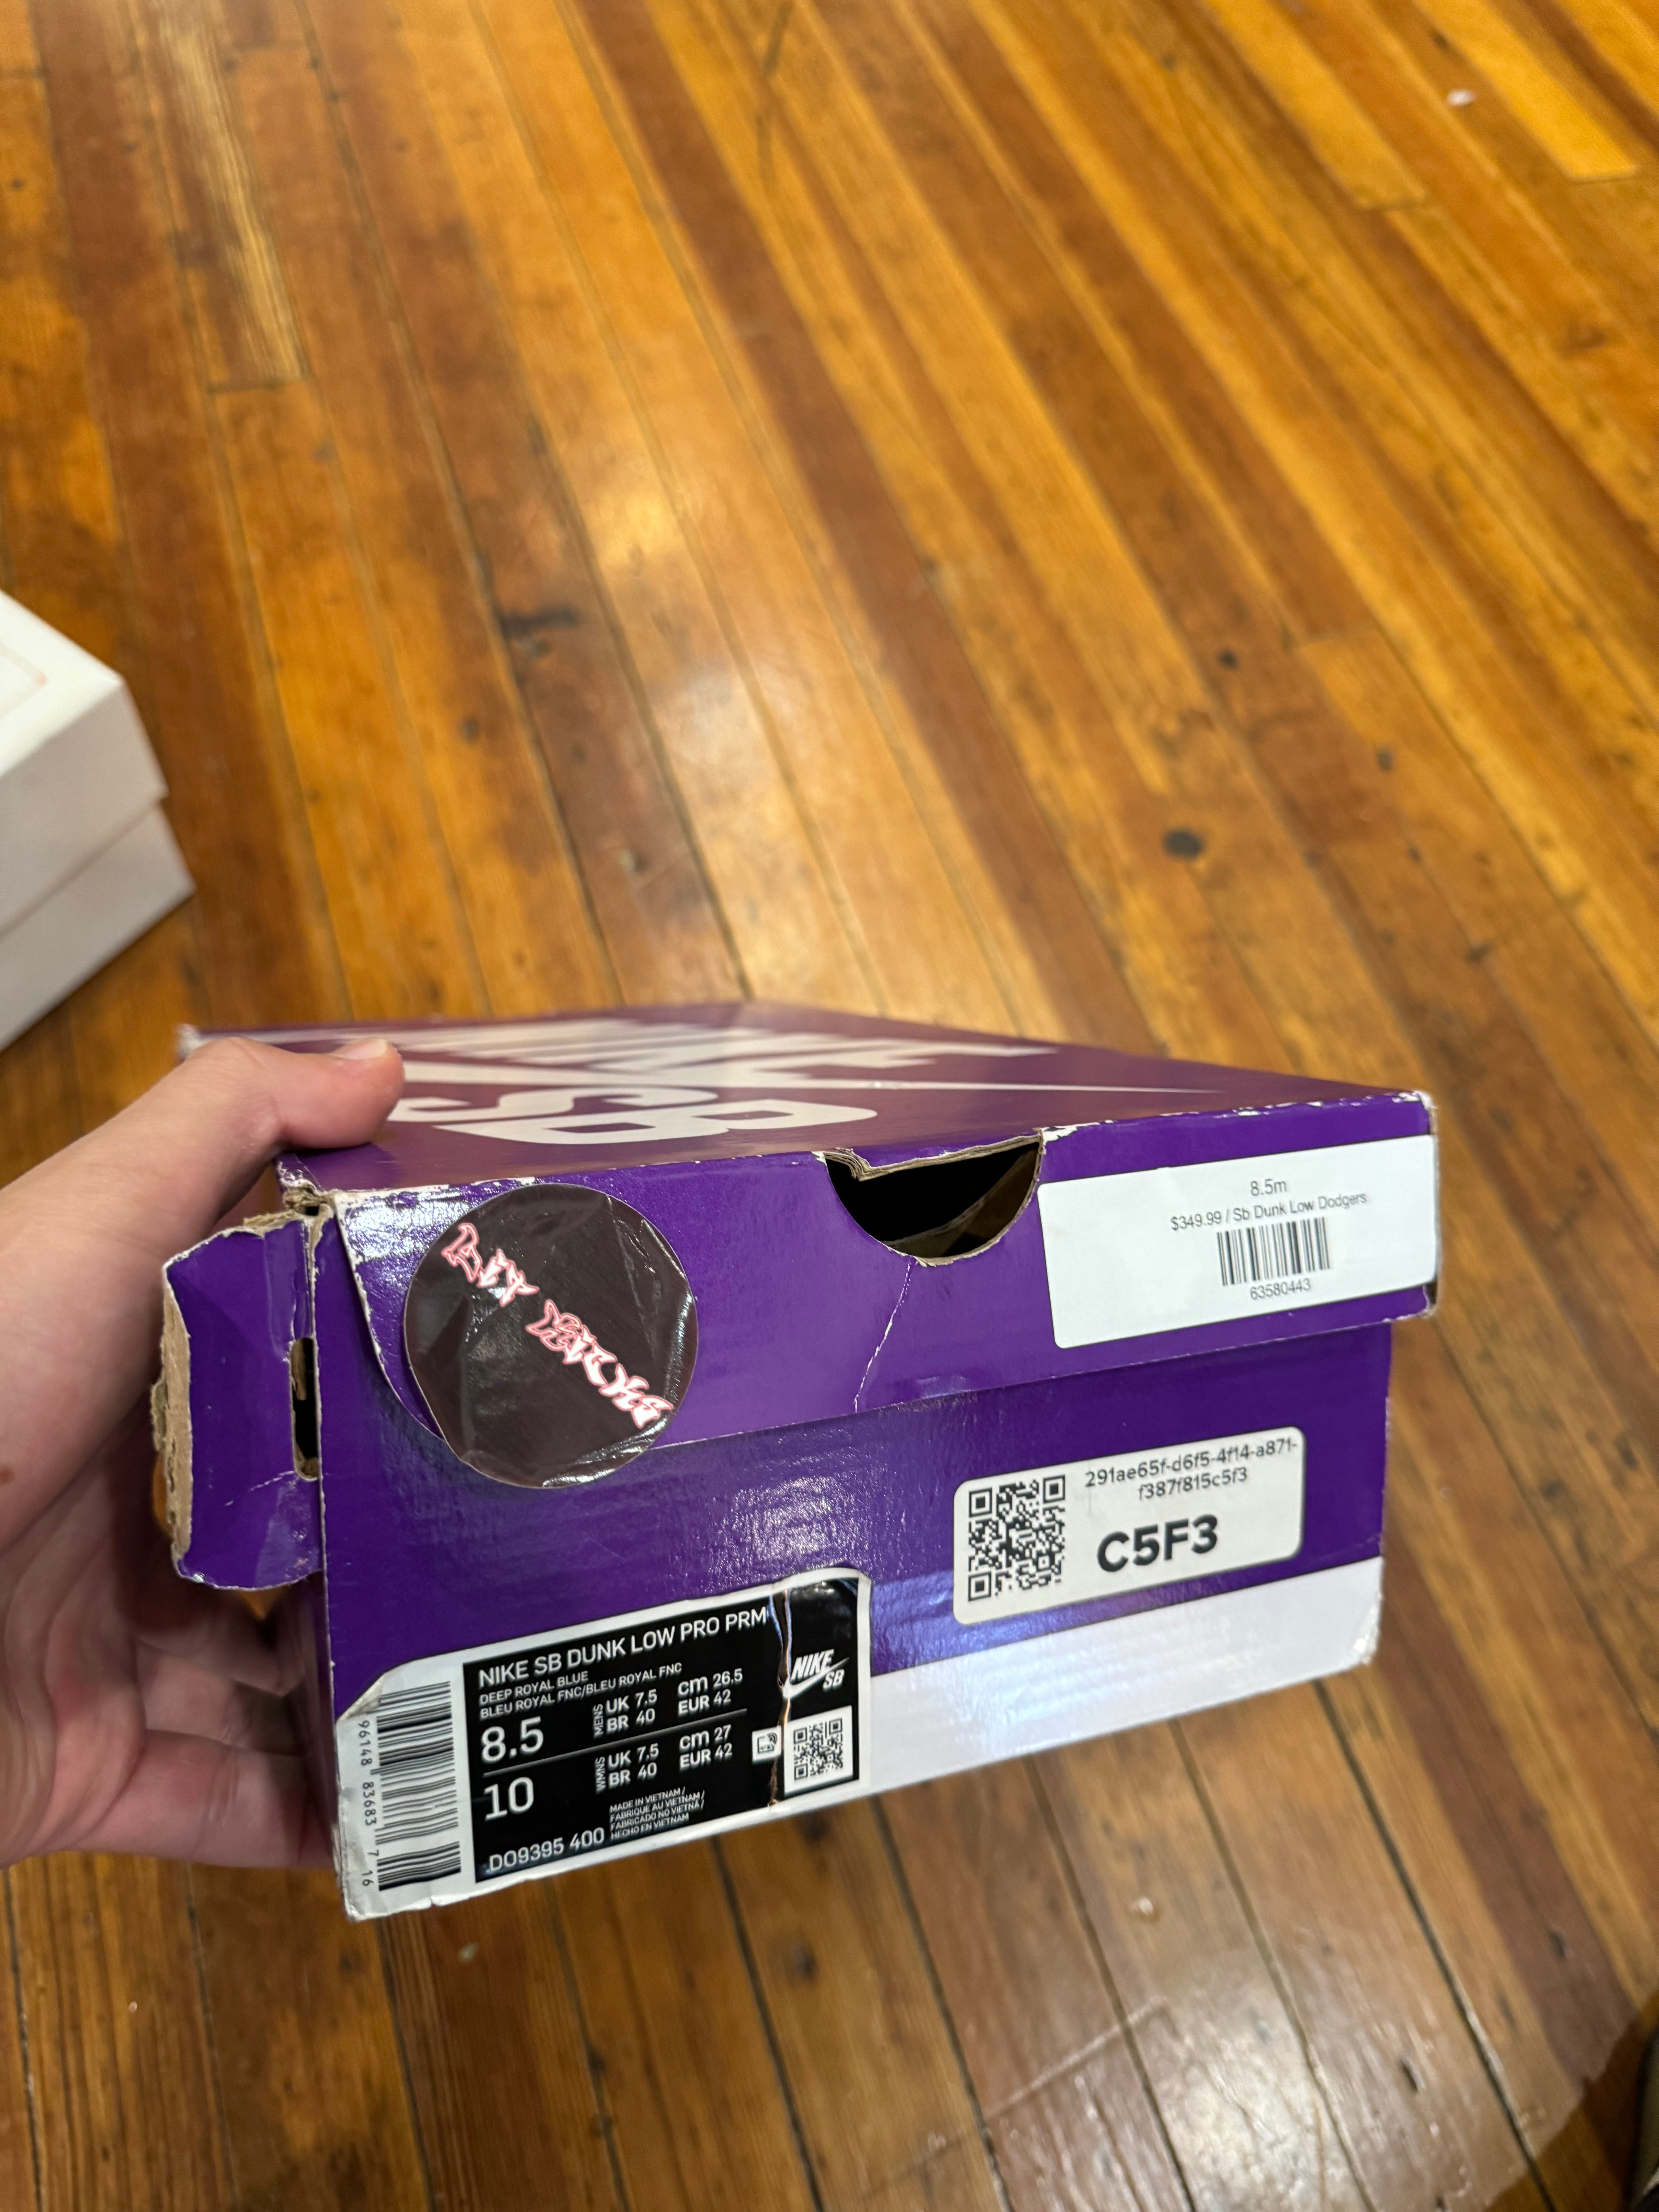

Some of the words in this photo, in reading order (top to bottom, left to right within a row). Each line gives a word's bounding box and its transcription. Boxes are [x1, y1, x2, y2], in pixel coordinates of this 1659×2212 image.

[388, 1085, 878, 1145] SB
[1250, 1178, 1287, 1197] 8.5m
[1171, 1211, 1221, 1231] $349.99
[1225, 1210, 1230, 1223] /
[1233, 1207, 1250, 1222] Sb
[1254, 1202, 1287, 1219] Dunk
[1290, 1200, 1314, 1214] Low
[1318, 1193, 1367, 1210] Dodgers
[1250, 1278, 1311, 1300] 63580443
[1085, 1438, 1297, 1487] 291ae65f-d6f5-4f14-a871-
[1139, 1467, 1248, 1500] f387f815c5f3
[1097, 1514, 1218, 1572] C5F3
[479, 1660, 529, 1689] NIKE
[534, 1653, 562, 1675] SB
[567, 1638, 626, 1669] DUNK
[631, 1628, 675, 1654] LOW
[681, 1616, 720, 1643] PRO
[725, 1606, 767, 1633] PRM
[792, 1649, 834, 1680] NIKE
[479, 1688, 512, 1705] DEEP
[515, 1679, 555, 1697] ROYAL
[557, 1671, 589, 1686] BLUE
[479, 1702, 513, 1720] BLEU
[515, 1693, 555, 1712] ROYAL
[557, 1678, 616, 1702] FNC/BLEU
[618, 1669, 656, 1688] ROYAL
[659, 1662, 682, 1678] FNC
[677, 1676, 708, 1697] cm
[712, 1668, 743, 1688] 26.5
[823, 1669, 845, 1690] SB
[606, 1695, 630, 1714] UK
[635, 1689, 658, 1707] 7.5
[678, 1695, 710, 1717] EUR
[713, 1689, 732, 1705] 42
[592, 1704, 603, 1738] MENS
[606, 1714, 629, 1734] BR
[635, 1708, 656, 1726] 40
[359, 1720, 373, 1766] 96148
[481, 1716, 543, 1764] 8.5
[679, 1731, 709, 1752] cm
[714, 1724, 732, 1743] 27
[608, 1750, 632, 1771] UK
[636, 1743, 659, 1765] 7.5
[679, 1749, 711, 1771] EUR
[714, 1743, 732, 1760] 42
[595, 1757, 606, 1794] WMNS
[608, 1769, 631, 1789] BR
[637, 1762, 657, 1781] 40
[362, 1781, 377, 1826] 83683
[484, 1776, 534, 1821] 10
[610, 1800, 633, 1813] MADE
[635, 1797, 644, 1806] IN
[610, 1805, 651, 1822] FABRIQUE
[652, 1802, 663, 1811] AU
[610, 1813, 656, 1832] FABRICADO
[658, 1809, 670, 1818] NO
[611, 1826, 639, 1840] HECHO
[641, 1822, 652, 1832] EN
[653, 1812, 689, 1829] VIETNAM
[570, 1827, 605, 1850] 400
[362, 1870, 374, 1887] 16
